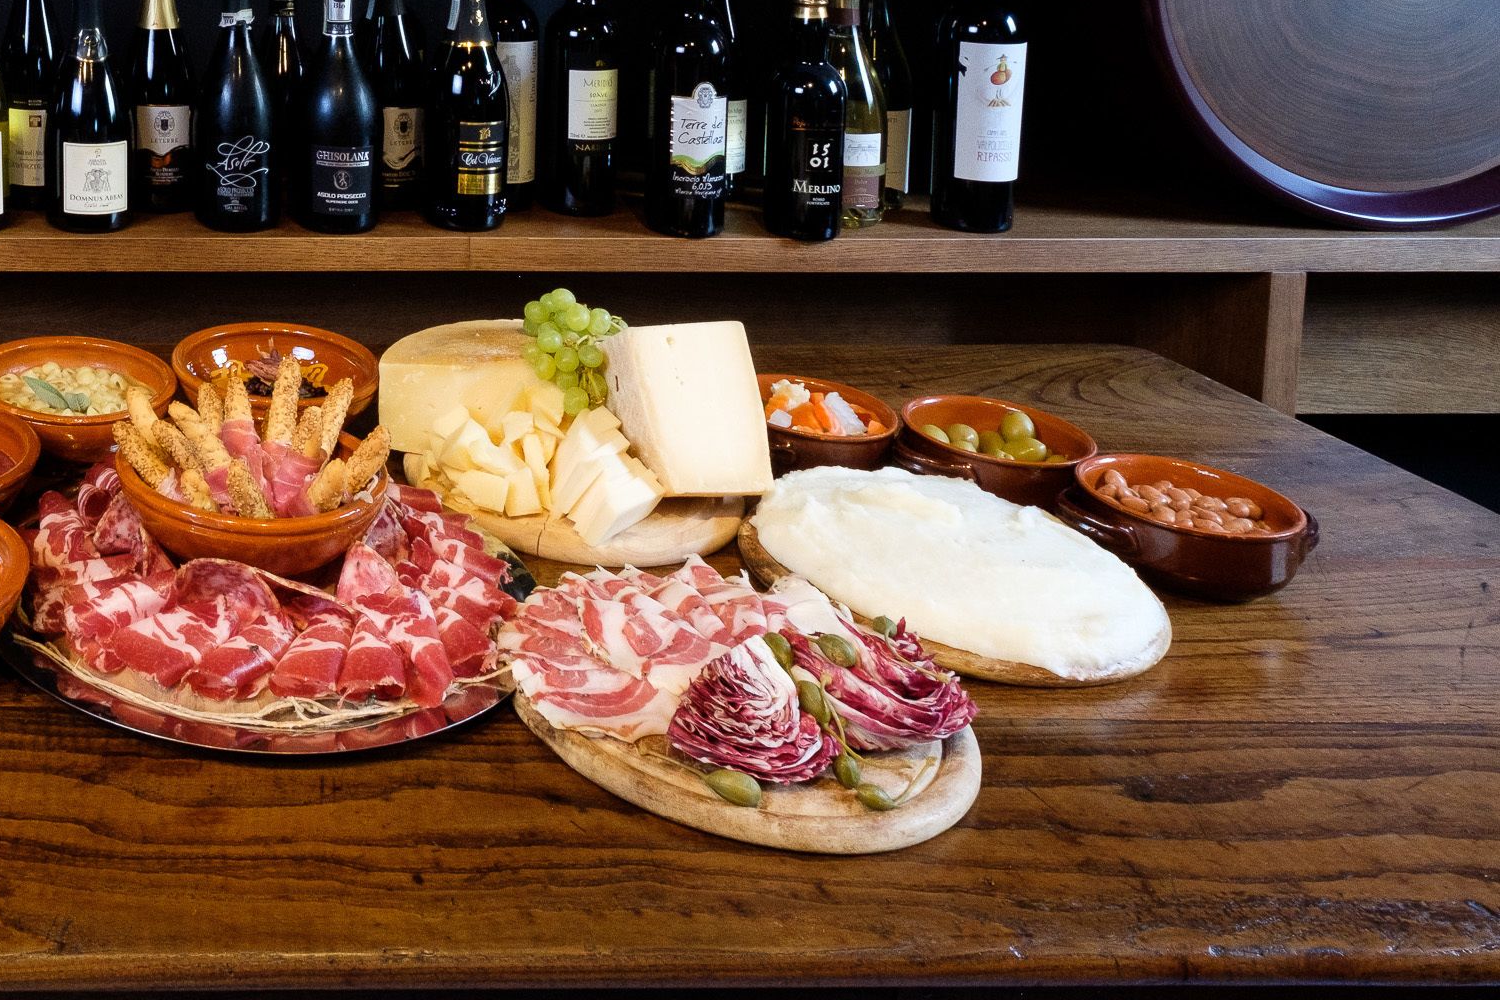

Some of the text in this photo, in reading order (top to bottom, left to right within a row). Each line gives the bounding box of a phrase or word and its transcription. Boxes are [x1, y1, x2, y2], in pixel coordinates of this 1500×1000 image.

[680, 116, 724, 130] Terre dei
[677, 131, 724, 146] Castellaz
[812, 143, 831, 156] 15
[316, 150, 370, 162] GHISOLANA
[977, 151, 1012, 162] RIPASSO
[793, 178, 841, 194] MERLINO
[69, 193, 103, 202] DOMNUS
[317, 191, 367, 200] ASOLO PROSECCO
